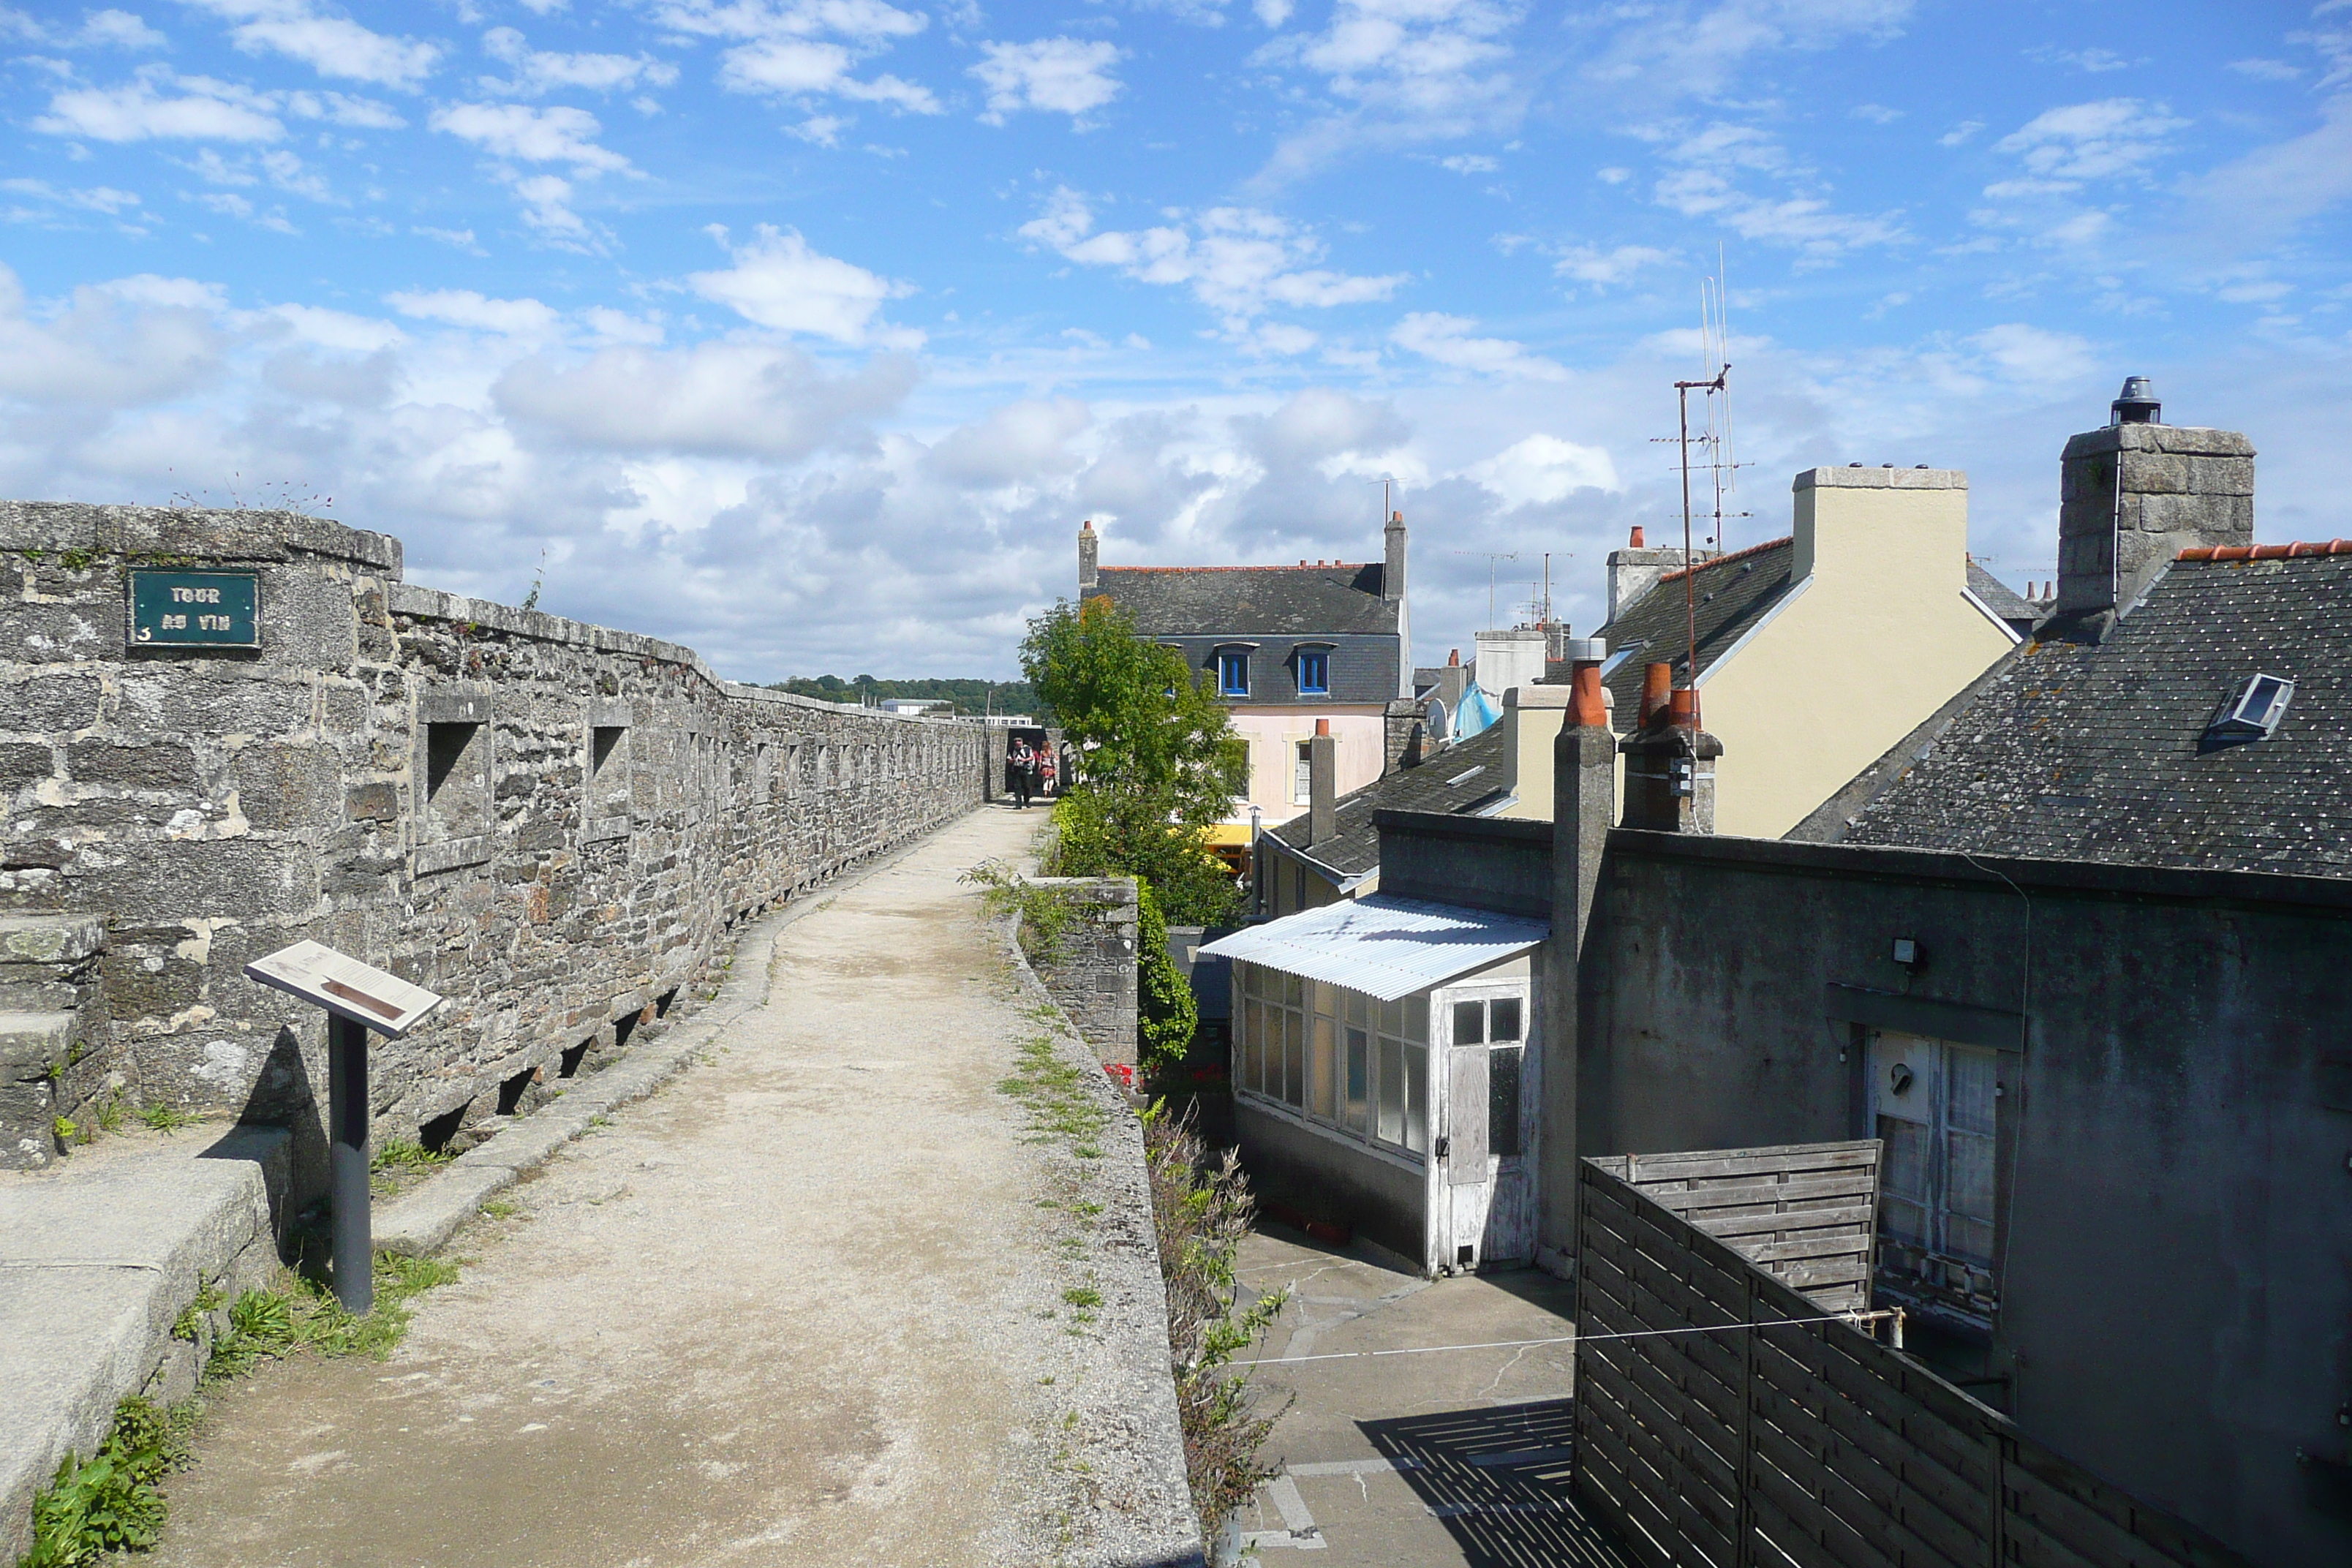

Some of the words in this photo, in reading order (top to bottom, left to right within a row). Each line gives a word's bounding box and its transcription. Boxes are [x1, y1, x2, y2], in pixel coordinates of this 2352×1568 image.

[170, 587, 220, 603] TOUR
[199, 614, 230, 630] VIN
[137, 627, 151, 641] 3
